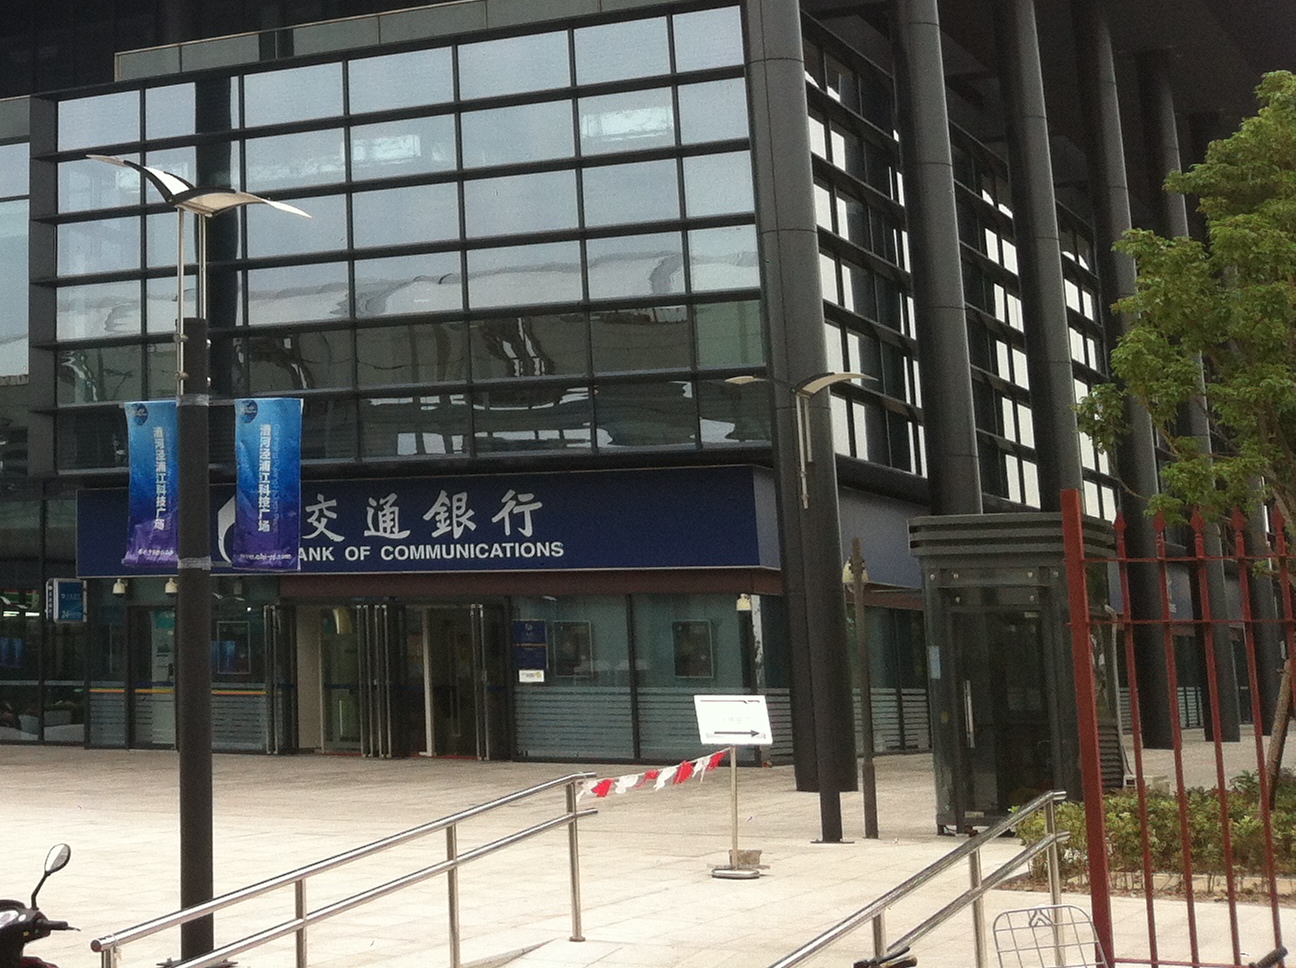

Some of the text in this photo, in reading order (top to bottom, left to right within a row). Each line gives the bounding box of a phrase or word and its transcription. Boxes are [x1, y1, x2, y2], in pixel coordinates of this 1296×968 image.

[301, 489, 543, 541] 交通銀行
[297, 542, 565, 563] ANK OF COMMUNICATIONS
